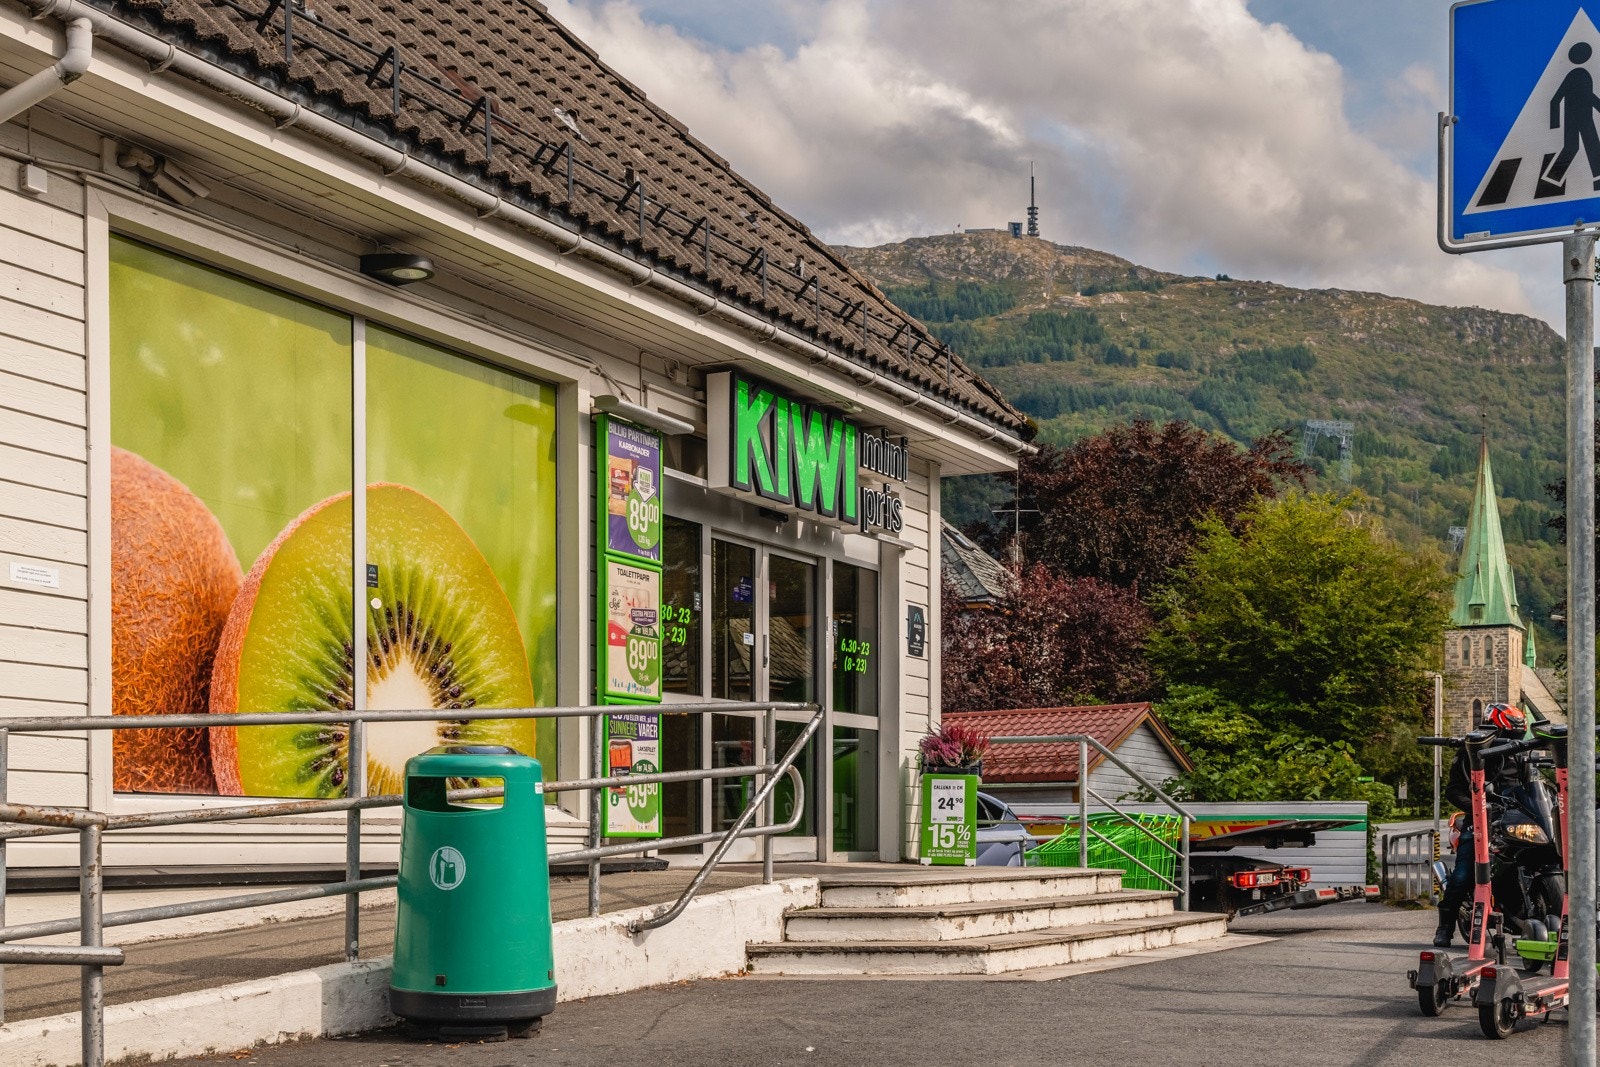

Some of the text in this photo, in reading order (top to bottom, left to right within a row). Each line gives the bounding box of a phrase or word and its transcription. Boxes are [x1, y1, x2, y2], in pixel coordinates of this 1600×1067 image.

[608, 422, 627, 438] BILLIG
[618, 440, 650, 458] KARBONADER
[732, 376, 858, 522] KIWI
[862, 427, 909, 483] mini
[861, 482, 904, 534] pris
[617, 567, 650, 582] TOALETTPAPIR
[609, 719, 658, 738] SUNNERE VARER
[928, 824, 971, 849] 15%
